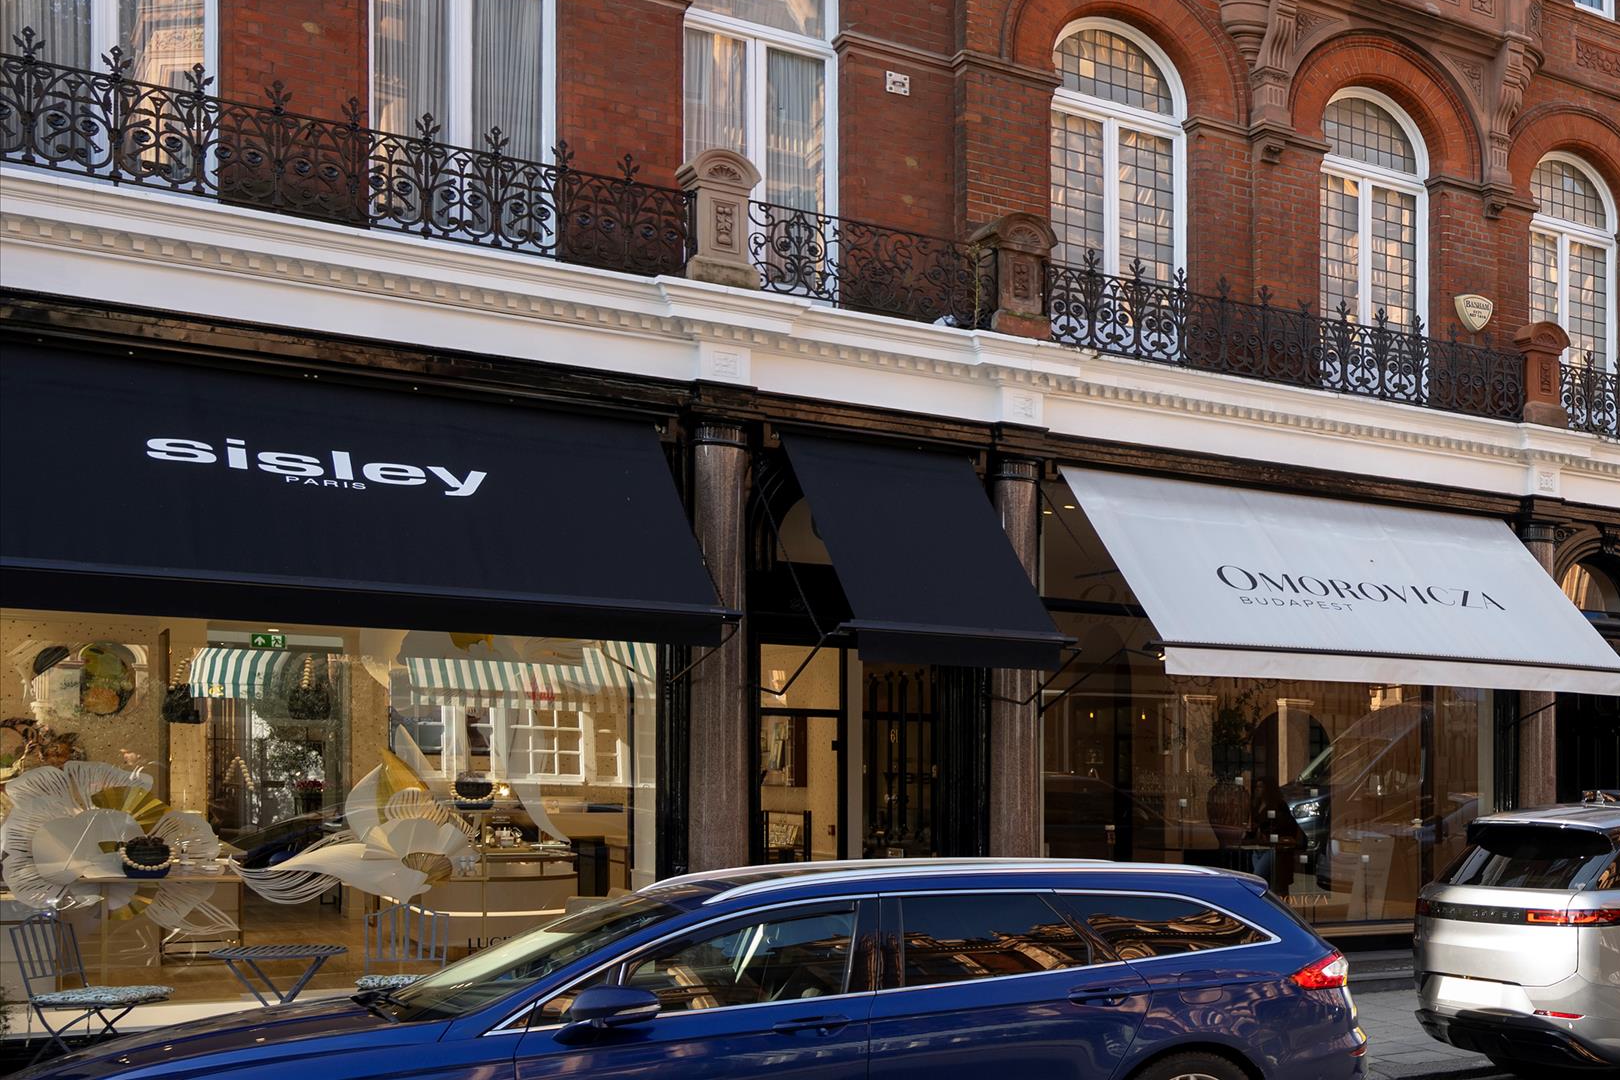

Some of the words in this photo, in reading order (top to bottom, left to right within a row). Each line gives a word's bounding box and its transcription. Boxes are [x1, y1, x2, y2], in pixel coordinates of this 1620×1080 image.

[146, 437, 488, 497] sisley
[286, 475, 367, 490] PARIS
[1216, 564, 1506, 612] OMOROVICZA
[1239, 595, 1353, 612] BUDAPEST
